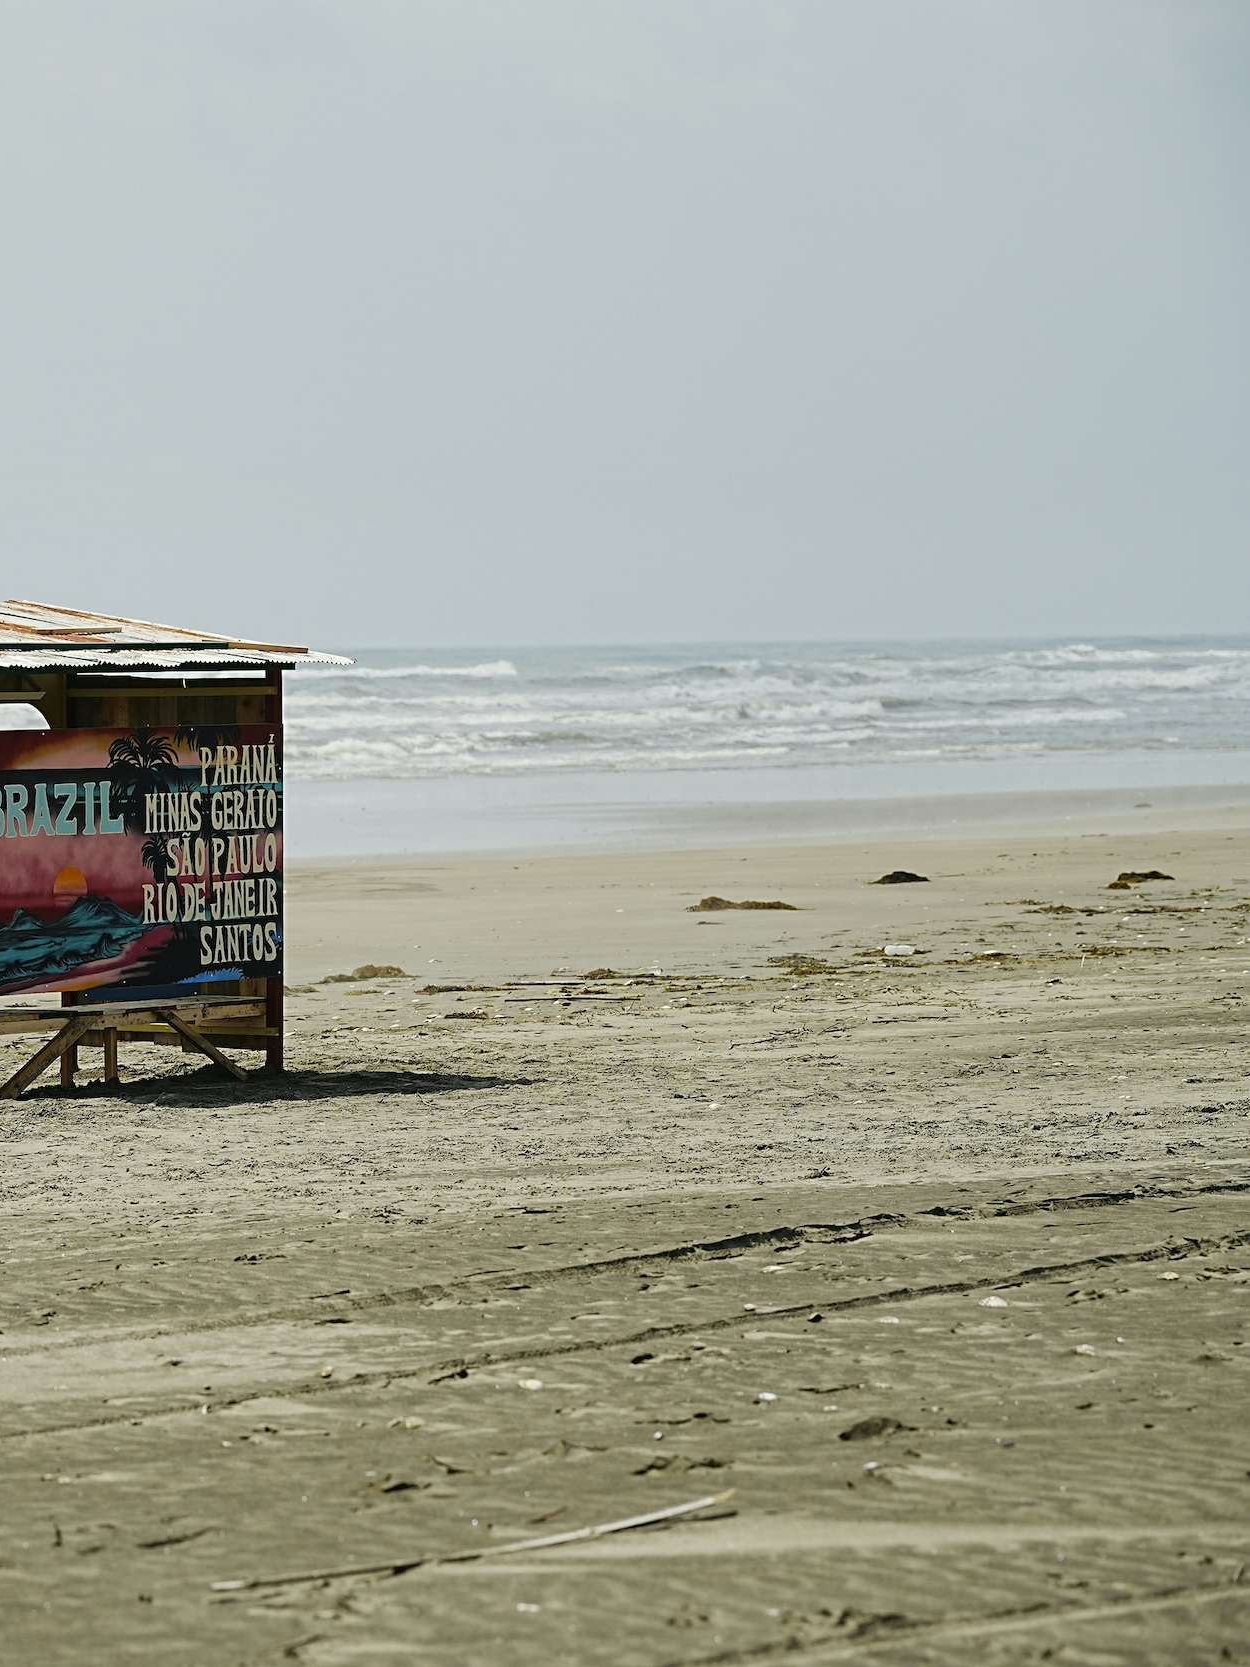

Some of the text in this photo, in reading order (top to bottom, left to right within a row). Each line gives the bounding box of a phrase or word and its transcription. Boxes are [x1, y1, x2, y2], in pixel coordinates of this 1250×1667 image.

[144, 791, 202, 833] MINAS
[166, 832, 277, 877] SÃO PAULO
[142, 882, 177, 925] RIO
[182, 881, 206, 923] DE
[200, 922, 277, 965] SANTOS
